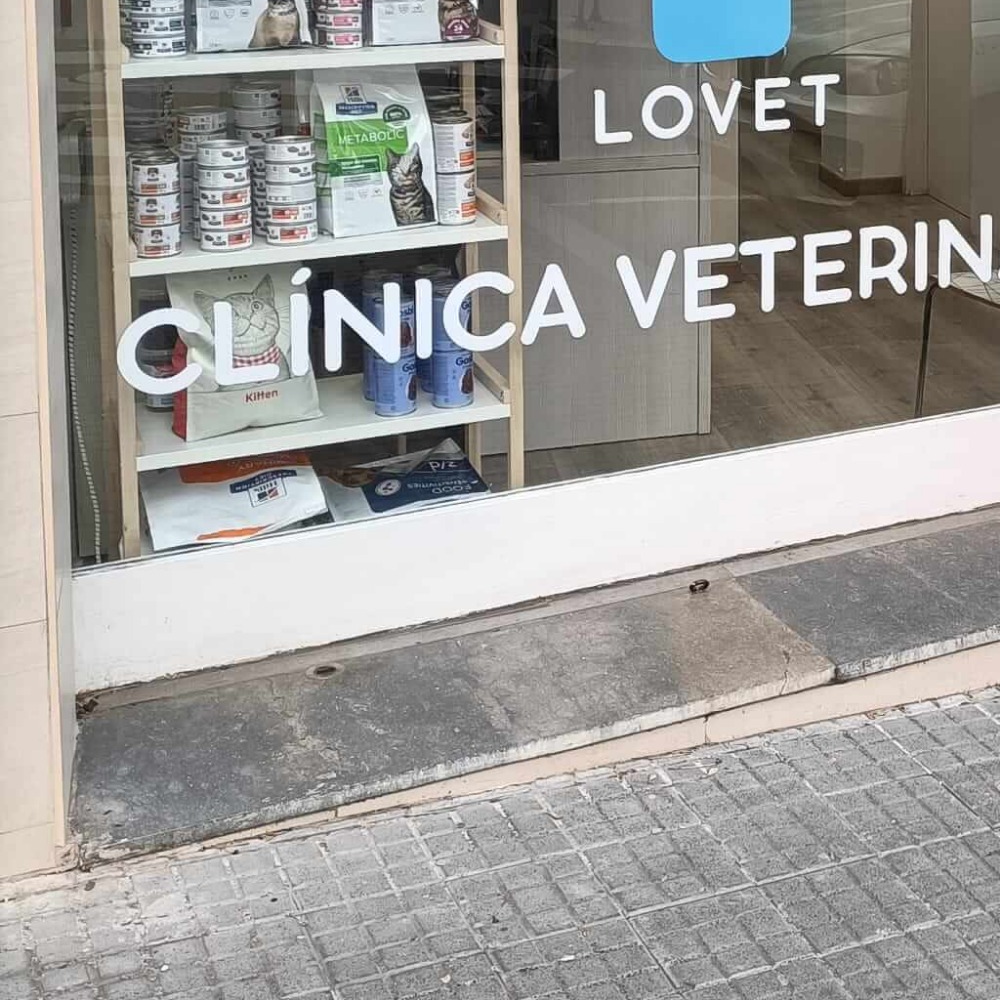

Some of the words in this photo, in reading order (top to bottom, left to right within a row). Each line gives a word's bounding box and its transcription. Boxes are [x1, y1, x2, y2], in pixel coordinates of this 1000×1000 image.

[593, 73, 840, 145] LOVET
[338, 129, 405, 145] METABOLIC
[116, 263, 587, 395] CLÍNICA
[245, 389, 279, 402] Kitten
